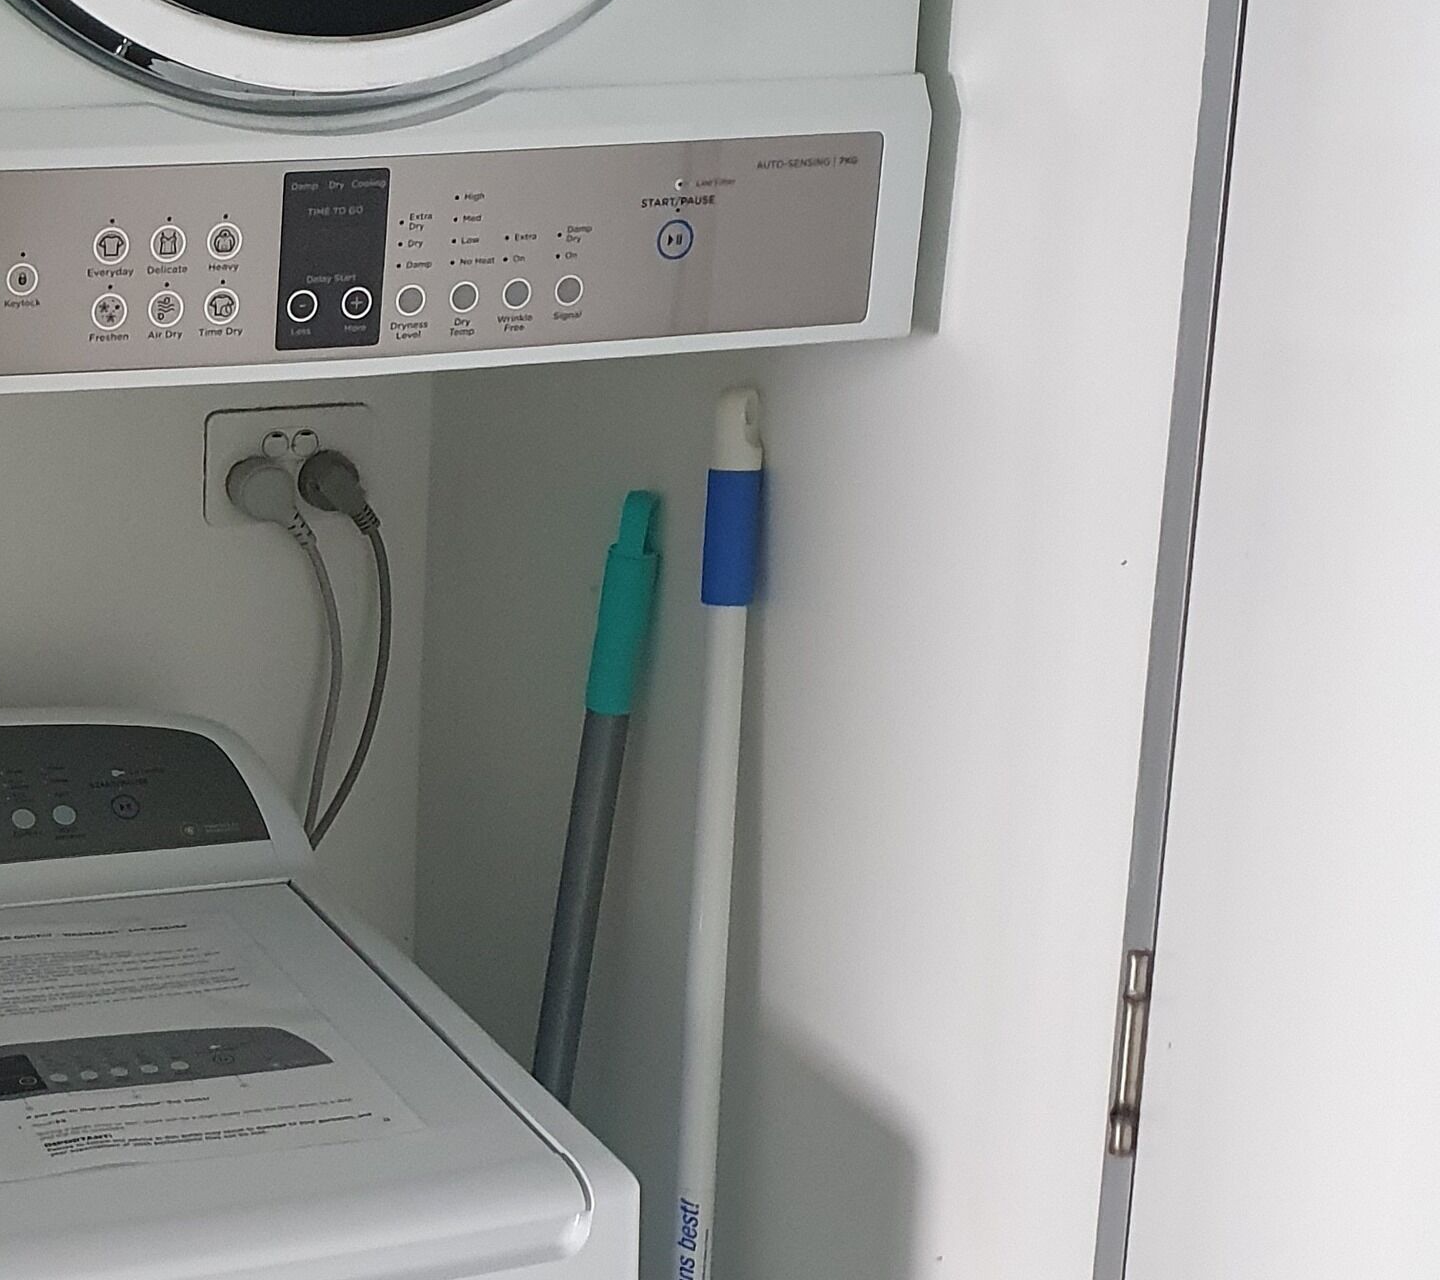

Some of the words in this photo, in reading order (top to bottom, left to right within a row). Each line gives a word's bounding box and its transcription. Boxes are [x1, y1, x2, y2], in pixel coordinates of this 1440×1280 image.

[756, 157, 831, 169] AUTO-SENSING
[838, 155, 858, 166] 7KG
[291, 181, 320, 192] Damp
[328, 179, 345, 191] Dry
[351, 178, 386, 190] Cooling
[464, 192, 485, 202] High
[641, 194, 716, 208] START/PAUSE
[308, 207, 331, 217] TIME
[333, 206, 345, 216] TO
[348, 205, 364, 215] GO
[409, 212, 433, 221] Extra
[463, 214, 482, 223] Med
[409, 222, 425, 231] Dry
[566, 224, 593, 234] Damp
[461, 236, 480, 245] Low
[514, 233, 537, 242] Extra
[566, 234, 582, 244] Dry
[407, 238, 424, 249] Dry
[513, 255, 526, 263] On
[564, 251, 578, 260] On
[406, 260, 433, 270] Damp
[460, 258, 472, 266] No
[474, 257, 496, 265] Heat
[87, 267, 134, 278] Everyday
[147, 265, 188, 275] Delicate
[208, 263, 239, 272] Heavy
[306, 274, 332, 285] Delay
[334, 273, 356, 283] Start
[497, 314, 533, 324] Wrinkle
[553, 311, 582, 321] Signal
[390, 321, 428, 331] Dryness
[454, 318, 471, 329] Dry
[504, 323, 525, 332] Free
[88, 332, 129, 342] Freshen
[148, 331, 162, 340] Air
[165, 330, 183, 340] Dry
[199, 328, 223, 337] Time
[225, 327, 243, 337] Dry
[396, 330, 421, 340] Level
[449, 327, 476, 337] Temp
[677, 1197, 700, 1252] best!
